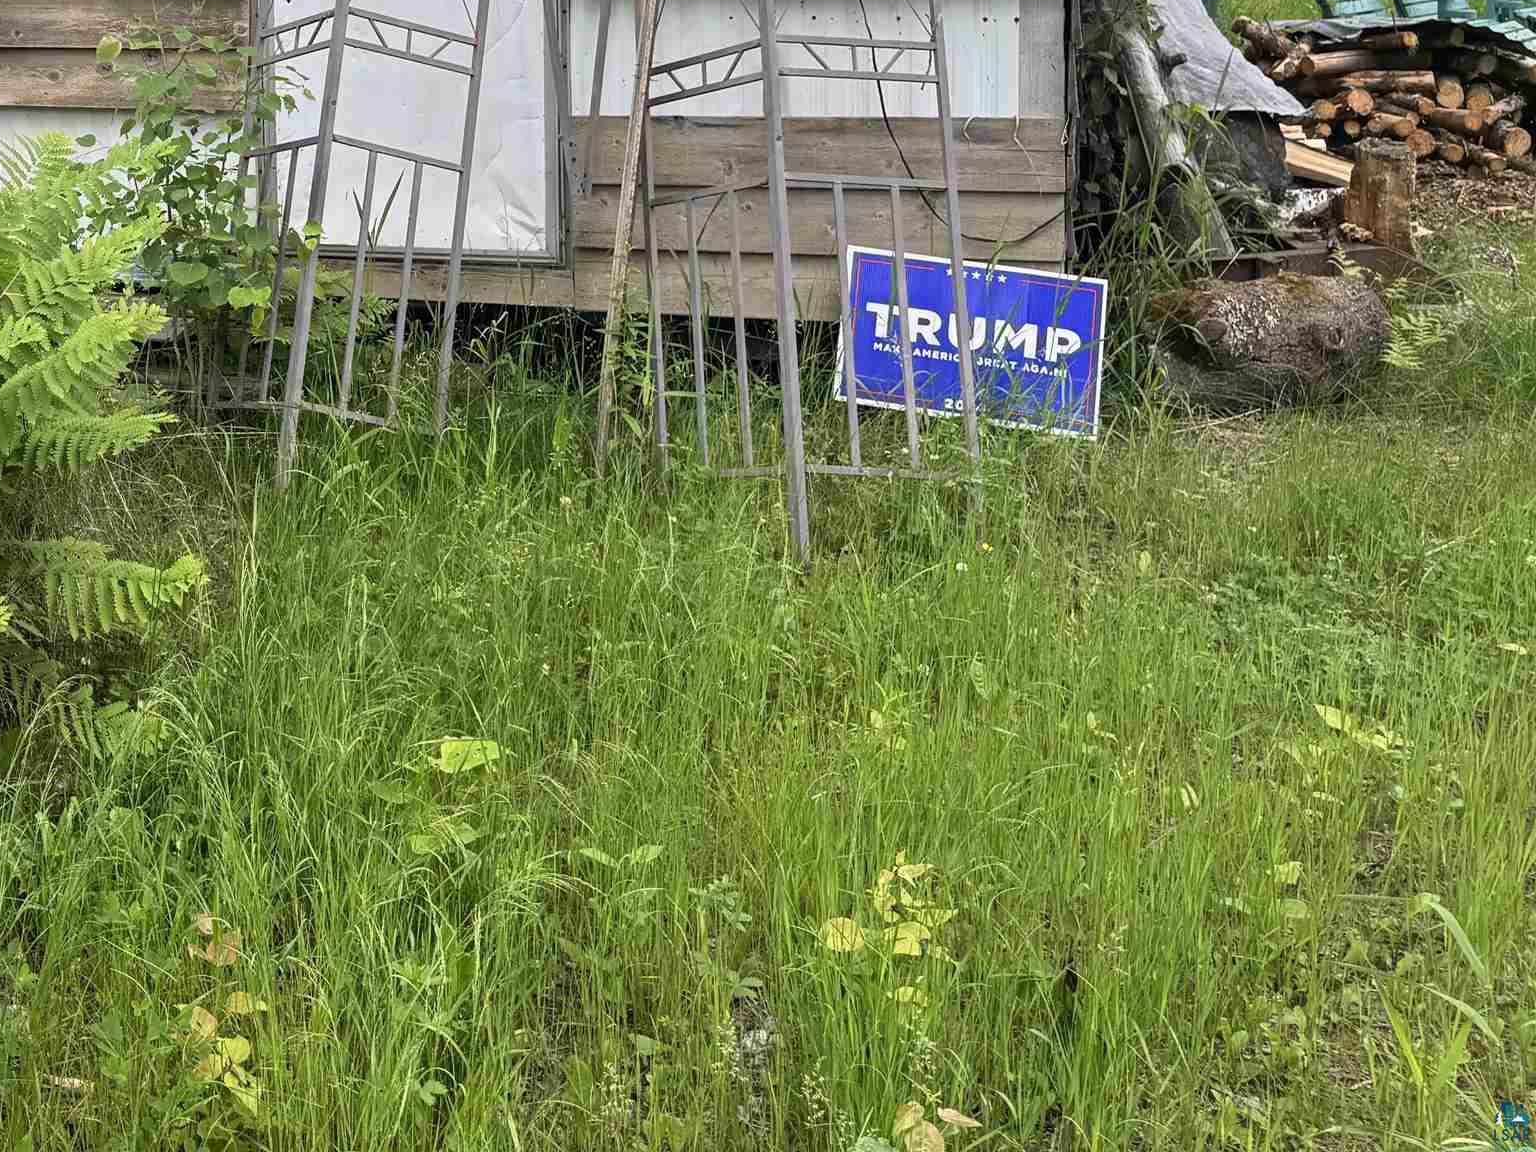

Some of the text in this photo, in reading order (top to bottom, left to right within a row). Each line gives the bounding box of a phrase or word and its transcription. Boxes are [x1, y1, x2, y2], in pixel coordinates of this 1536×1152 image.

[865, 302, 1082, 364] TRUMP
[873, 341, 903, 355] MAK
[912, 347, 962, 363] AMERIC
